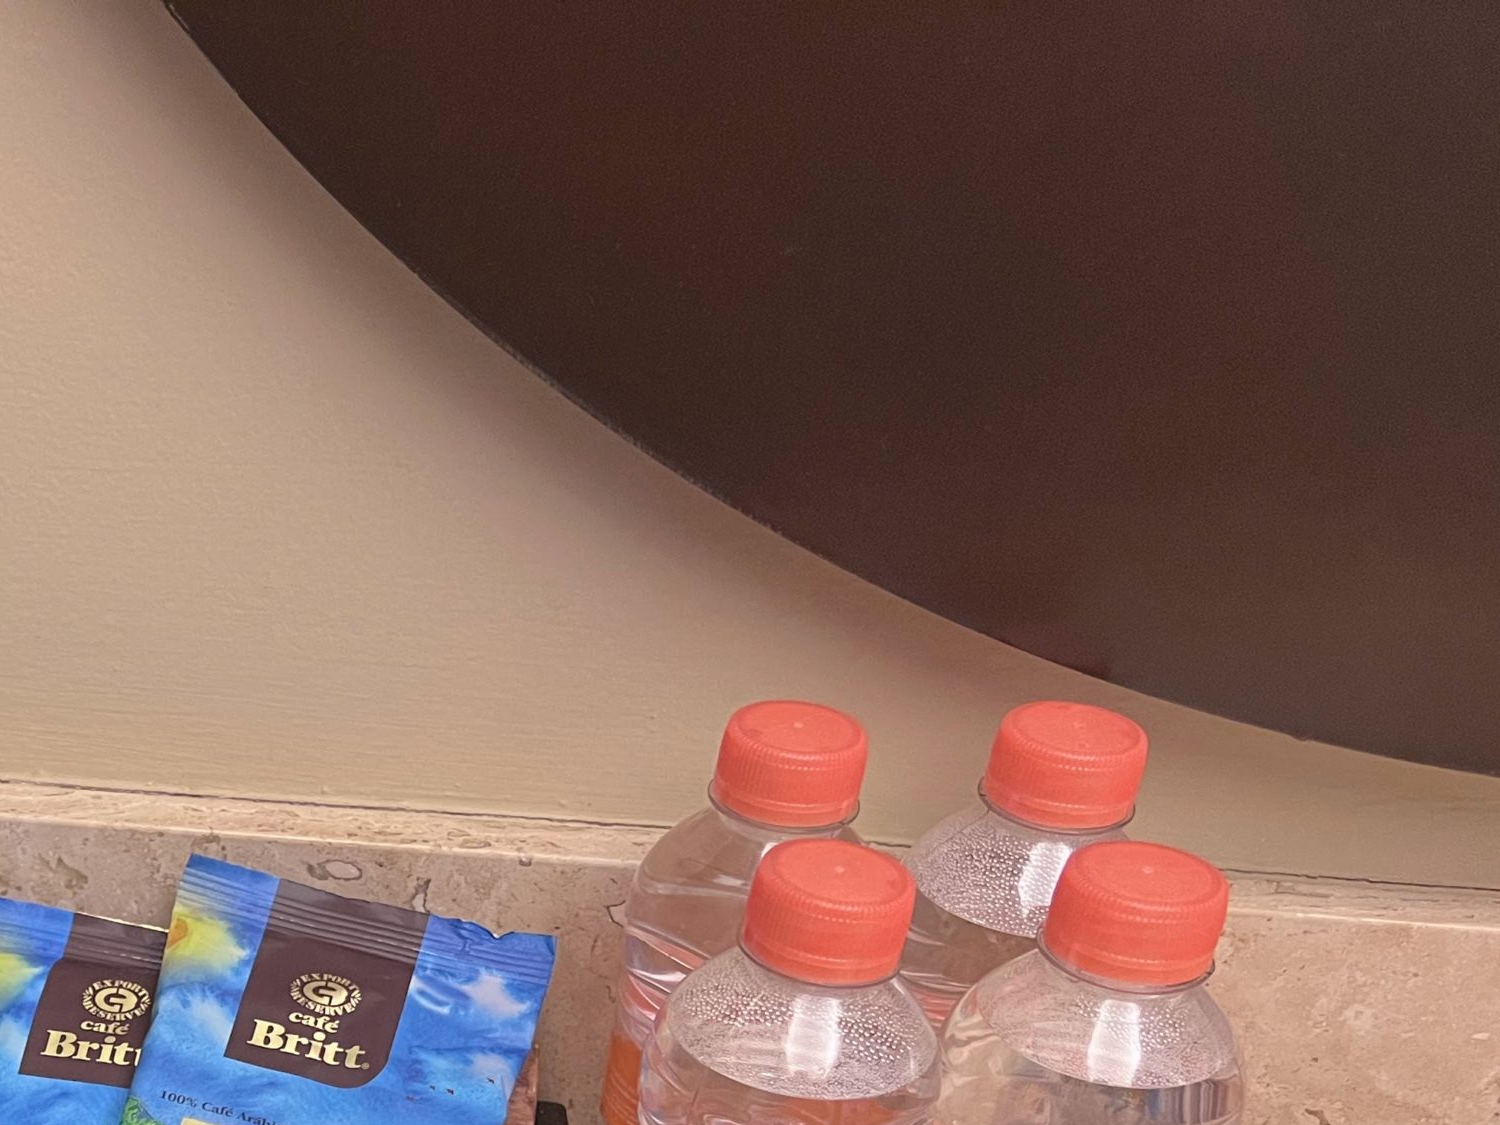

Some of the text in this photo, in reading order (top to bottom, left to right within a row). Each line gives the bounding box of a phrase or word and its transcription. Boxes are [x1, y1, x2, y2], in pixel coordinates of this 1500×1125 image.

[80, 1020, 130, 1035] café
[288, 1012, 340, 1033] café
[160, 1090, 197, 1107] 100%
[202, 1102, 233, 1117] Café
